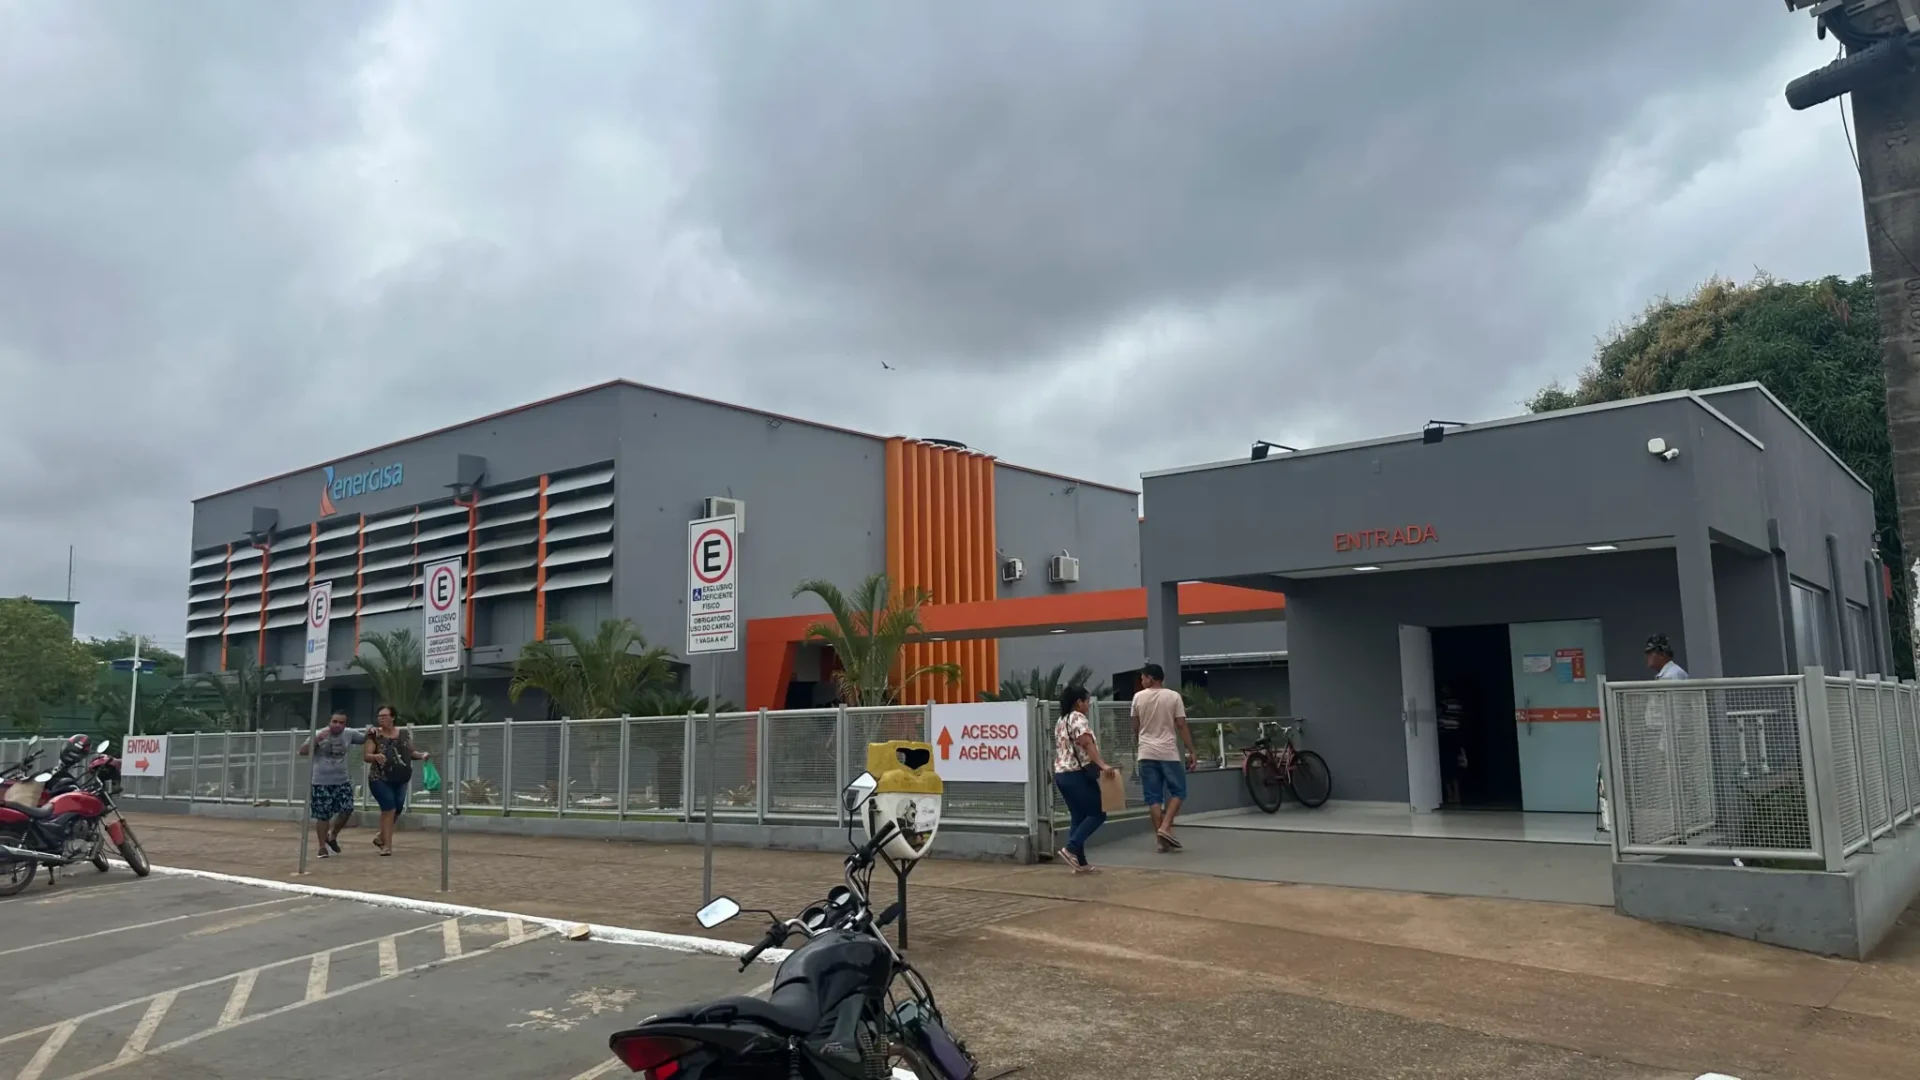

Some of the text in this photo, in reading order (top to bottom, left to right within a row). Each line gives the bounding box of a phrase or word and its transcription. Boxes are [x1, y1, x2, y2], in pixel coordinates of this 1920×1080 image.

[1334, 523, 1438, 552] ENTRADA
[704, 540, 721, 573] E
[438, 575, 447, 601] E
[703, 583, 733, 592] EXCLUSIVO
[702, 591, 733, 601] DEFICIENTE
[316, 597, 323, 620] E
[702, 602, 720, 610] FÍSICO
[428, 612, 456, 624] EXCLUSIVO
[694, 615, 730, 624] OBRIGATÓRIO
[961, 724, 1018, 739] ACESSO
[127, 739, 160, 754] ENTRADA
[959, 742, 1021, 760] AGÊNCIA
